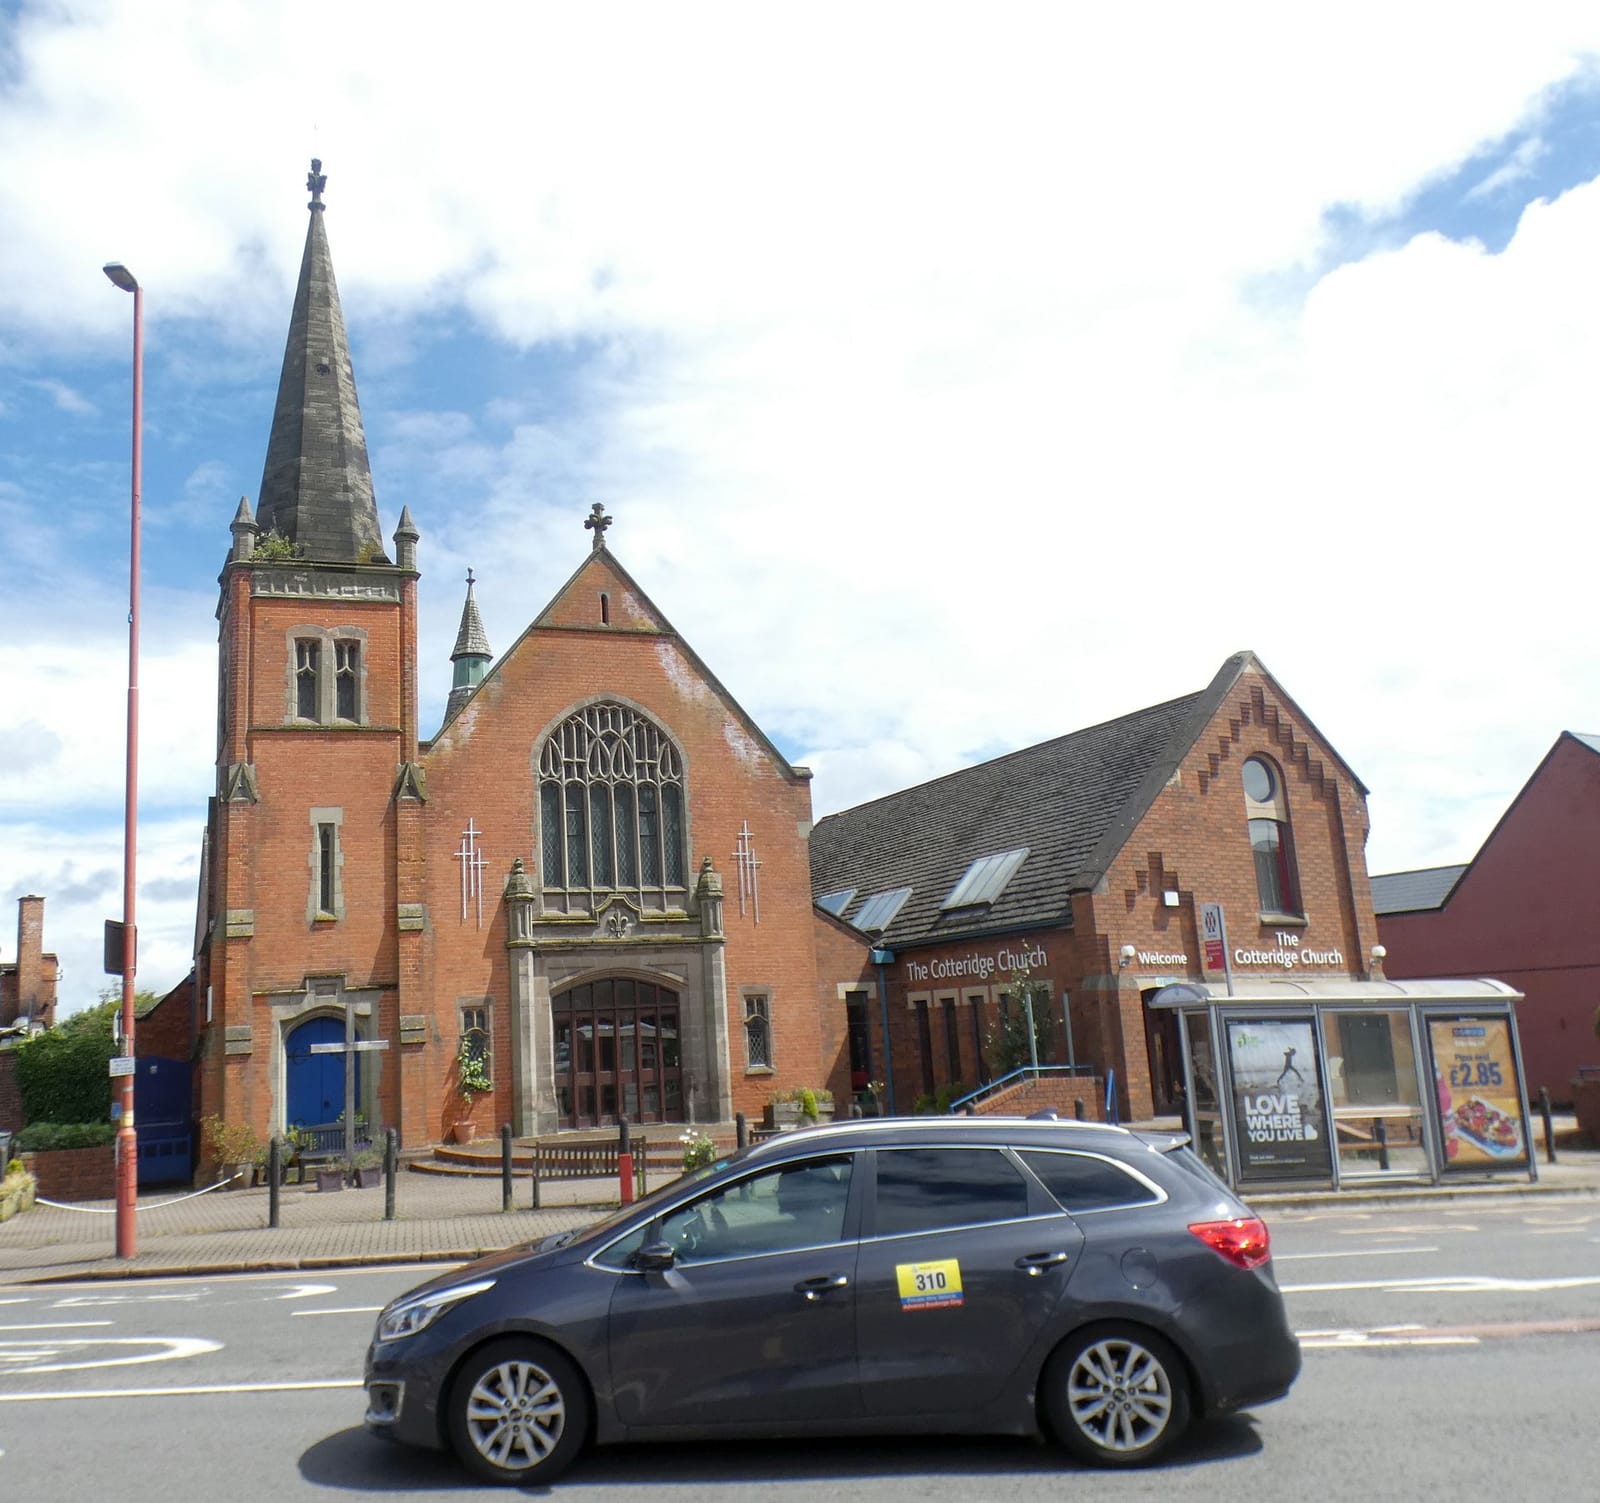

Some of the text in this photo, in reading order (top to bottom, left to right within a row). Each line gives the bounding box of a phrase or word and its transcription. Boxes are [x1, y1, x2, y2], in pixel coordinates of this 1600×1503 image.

[1275, 931, 1299, 946] The
[906, 944, 1047, 981] The Cotteridge Church
[1138, 951, 1188, 965] Welcome
[1234, 948, 1298, 968] Cotteridge
[1301, 947, 1343, 964] Church
[1450, 1062, 1503, 1087] £2.85
[1244, 1094, 1300, 1115] LOVE
[1246, 1114, 1302, 1130] WHERE
[1247, 1129, 1304, 1143] YOU LIVE
[916, 1272, 946, 1291] 310
